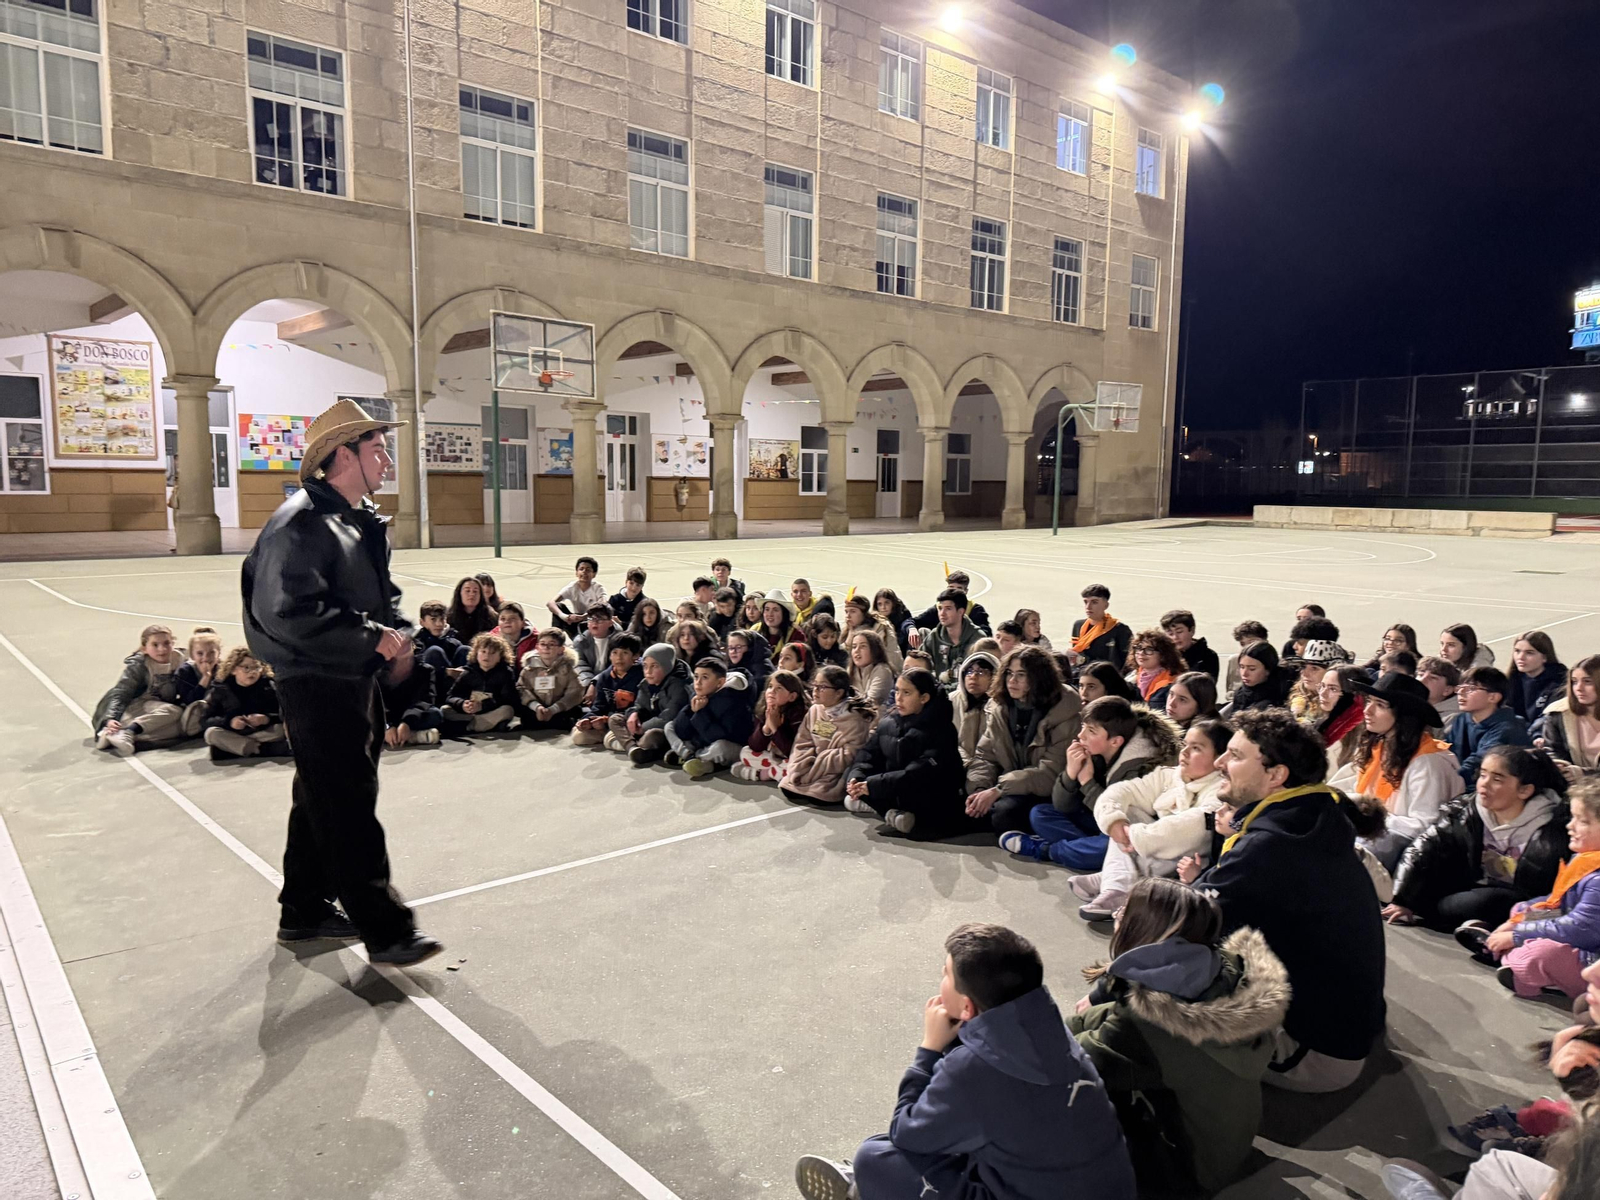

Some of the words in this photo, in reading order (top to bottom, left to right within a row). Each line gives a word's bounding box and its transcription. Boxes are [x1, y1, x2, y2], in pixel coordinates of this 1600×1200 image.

[1581, 332, 1600, 345] ZAR
[83, 345, 110, 359] DON
[111, 346, 149, 361] BOSCO
